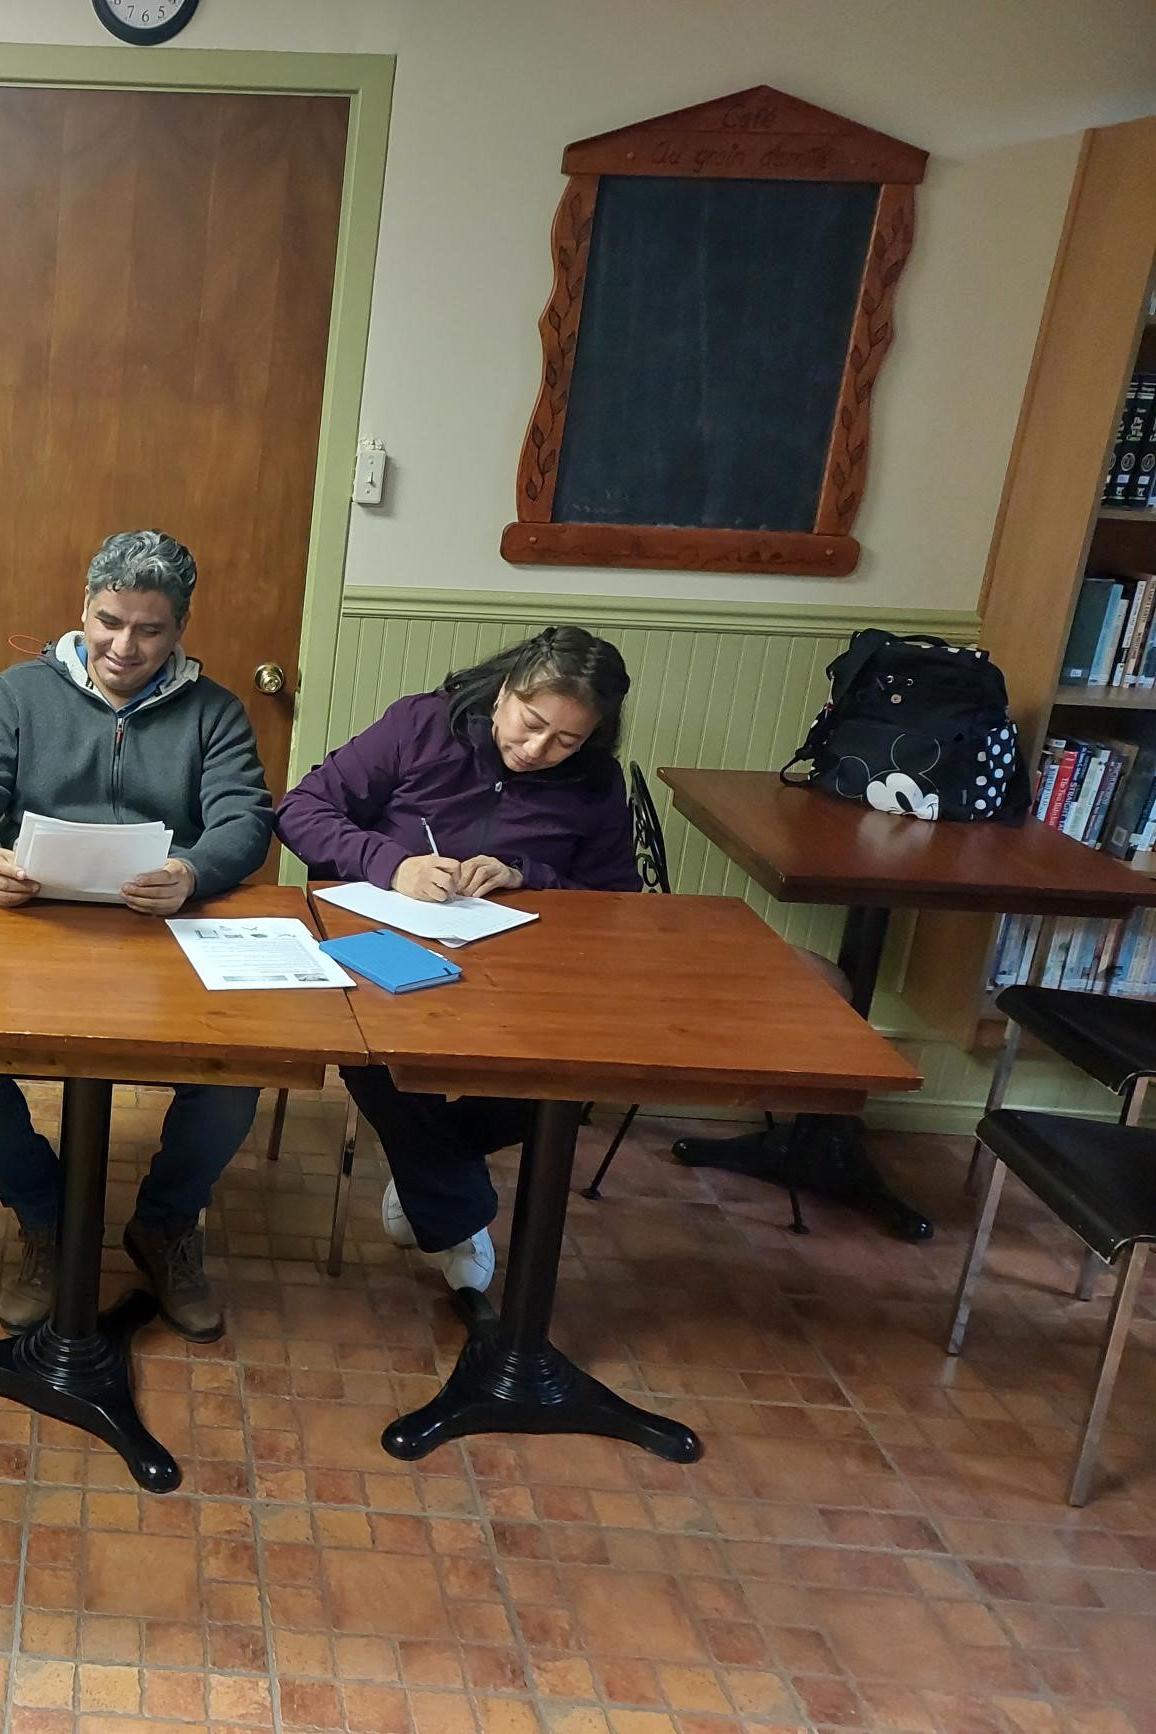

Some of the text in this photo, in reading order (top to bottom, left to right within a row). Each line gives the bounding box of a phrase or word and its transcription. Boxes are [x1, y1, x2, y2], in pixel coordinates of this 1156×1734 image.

[127, 5, 135, 18] 7
[142, 10, 150, 22] 6
[158, 6, 165, 19] 5
